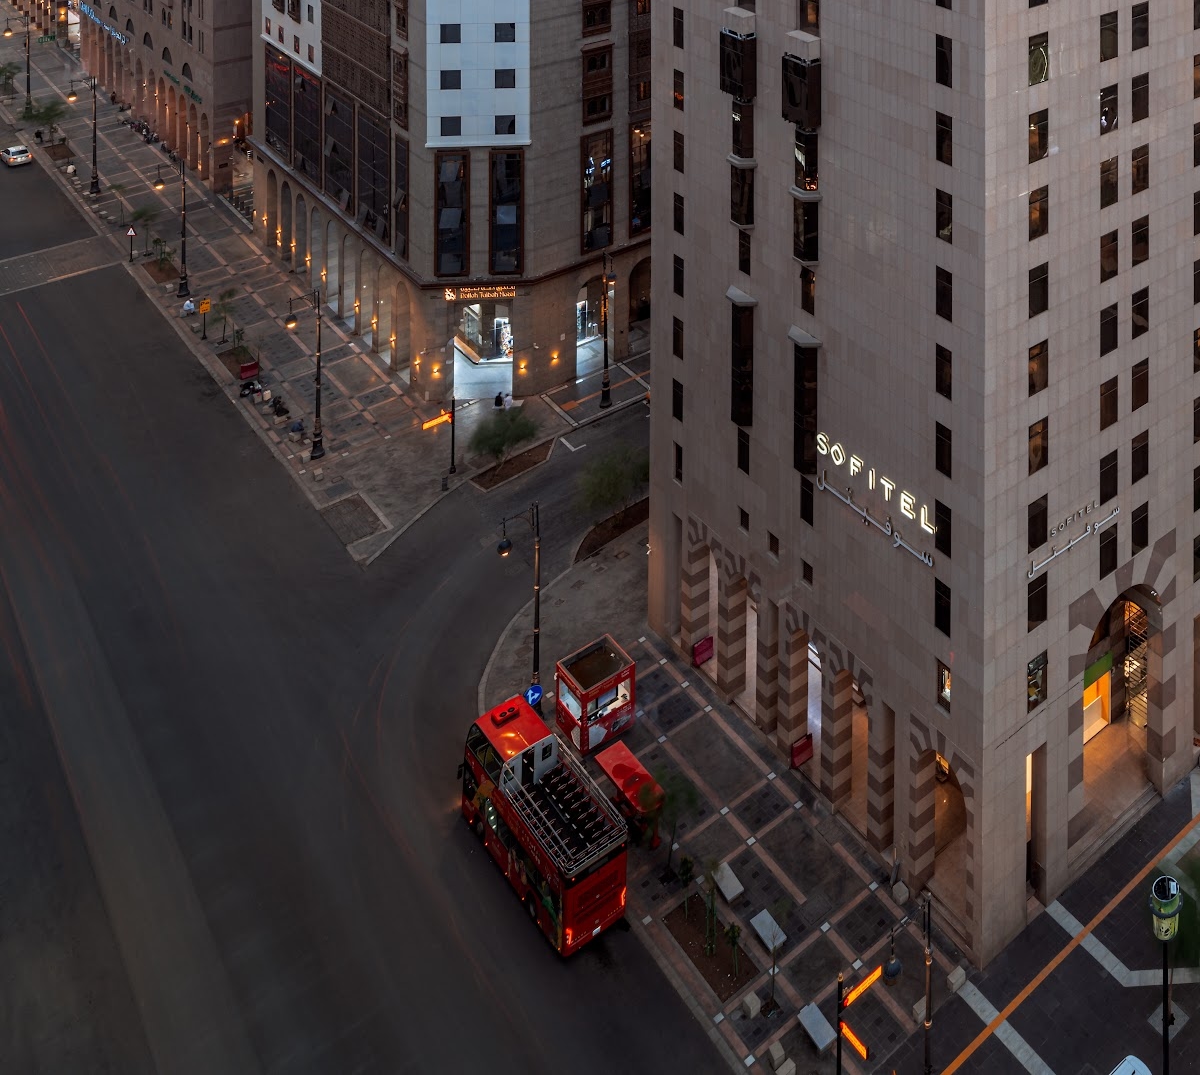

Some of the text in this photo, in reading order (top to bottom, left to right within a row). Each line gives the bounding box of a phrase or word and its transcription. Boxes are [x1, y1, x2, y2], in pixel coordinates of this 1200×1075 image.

[816, 431, 938, 535] SOFITEL
[816, 468, 935, 567] سوفيتل
[1050, 500, 1101, 537] SOFITEL
[1027, 506, 1121, 578] سوفيتل
